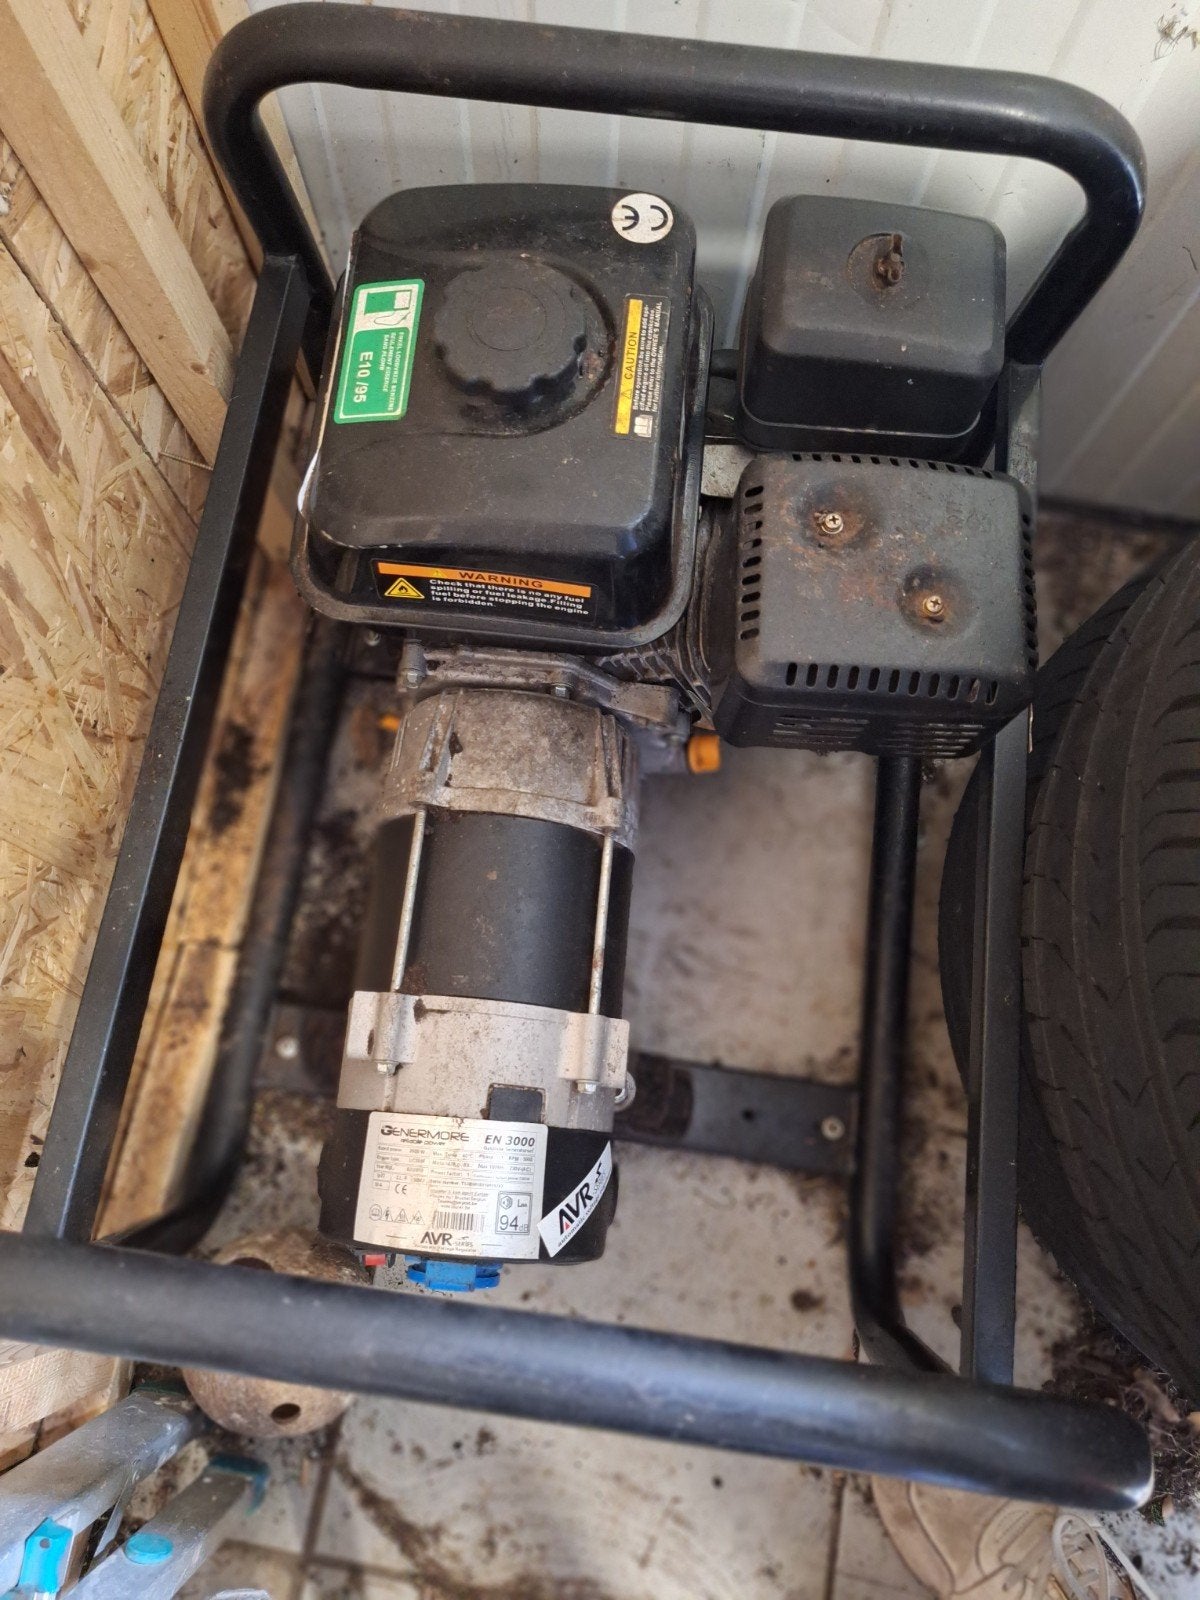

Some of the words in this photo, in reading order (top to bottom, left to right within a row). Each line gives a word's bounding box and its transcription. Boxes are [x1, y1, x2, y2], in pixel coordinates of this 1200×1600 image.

[654, 302, 662, 327] MANUAL
[358, 351, 373, 378] E10
[624, 332, 637, 380] CAUTION
[459, 572, 543, 588] WARNING
[489, 597, 534, 607] stopping
[554, 606, 588, 615] engine
[381, 1125, 469, 1142] GENERMORE
[485, 1135, 502, 1144] EN
[505, 1136, 535, 1146] 3000
[558, 1183, 593, 1235] AVR
[500, 1215, 518, 1231] 94
[421, 1232, 452, 1246] AVR
